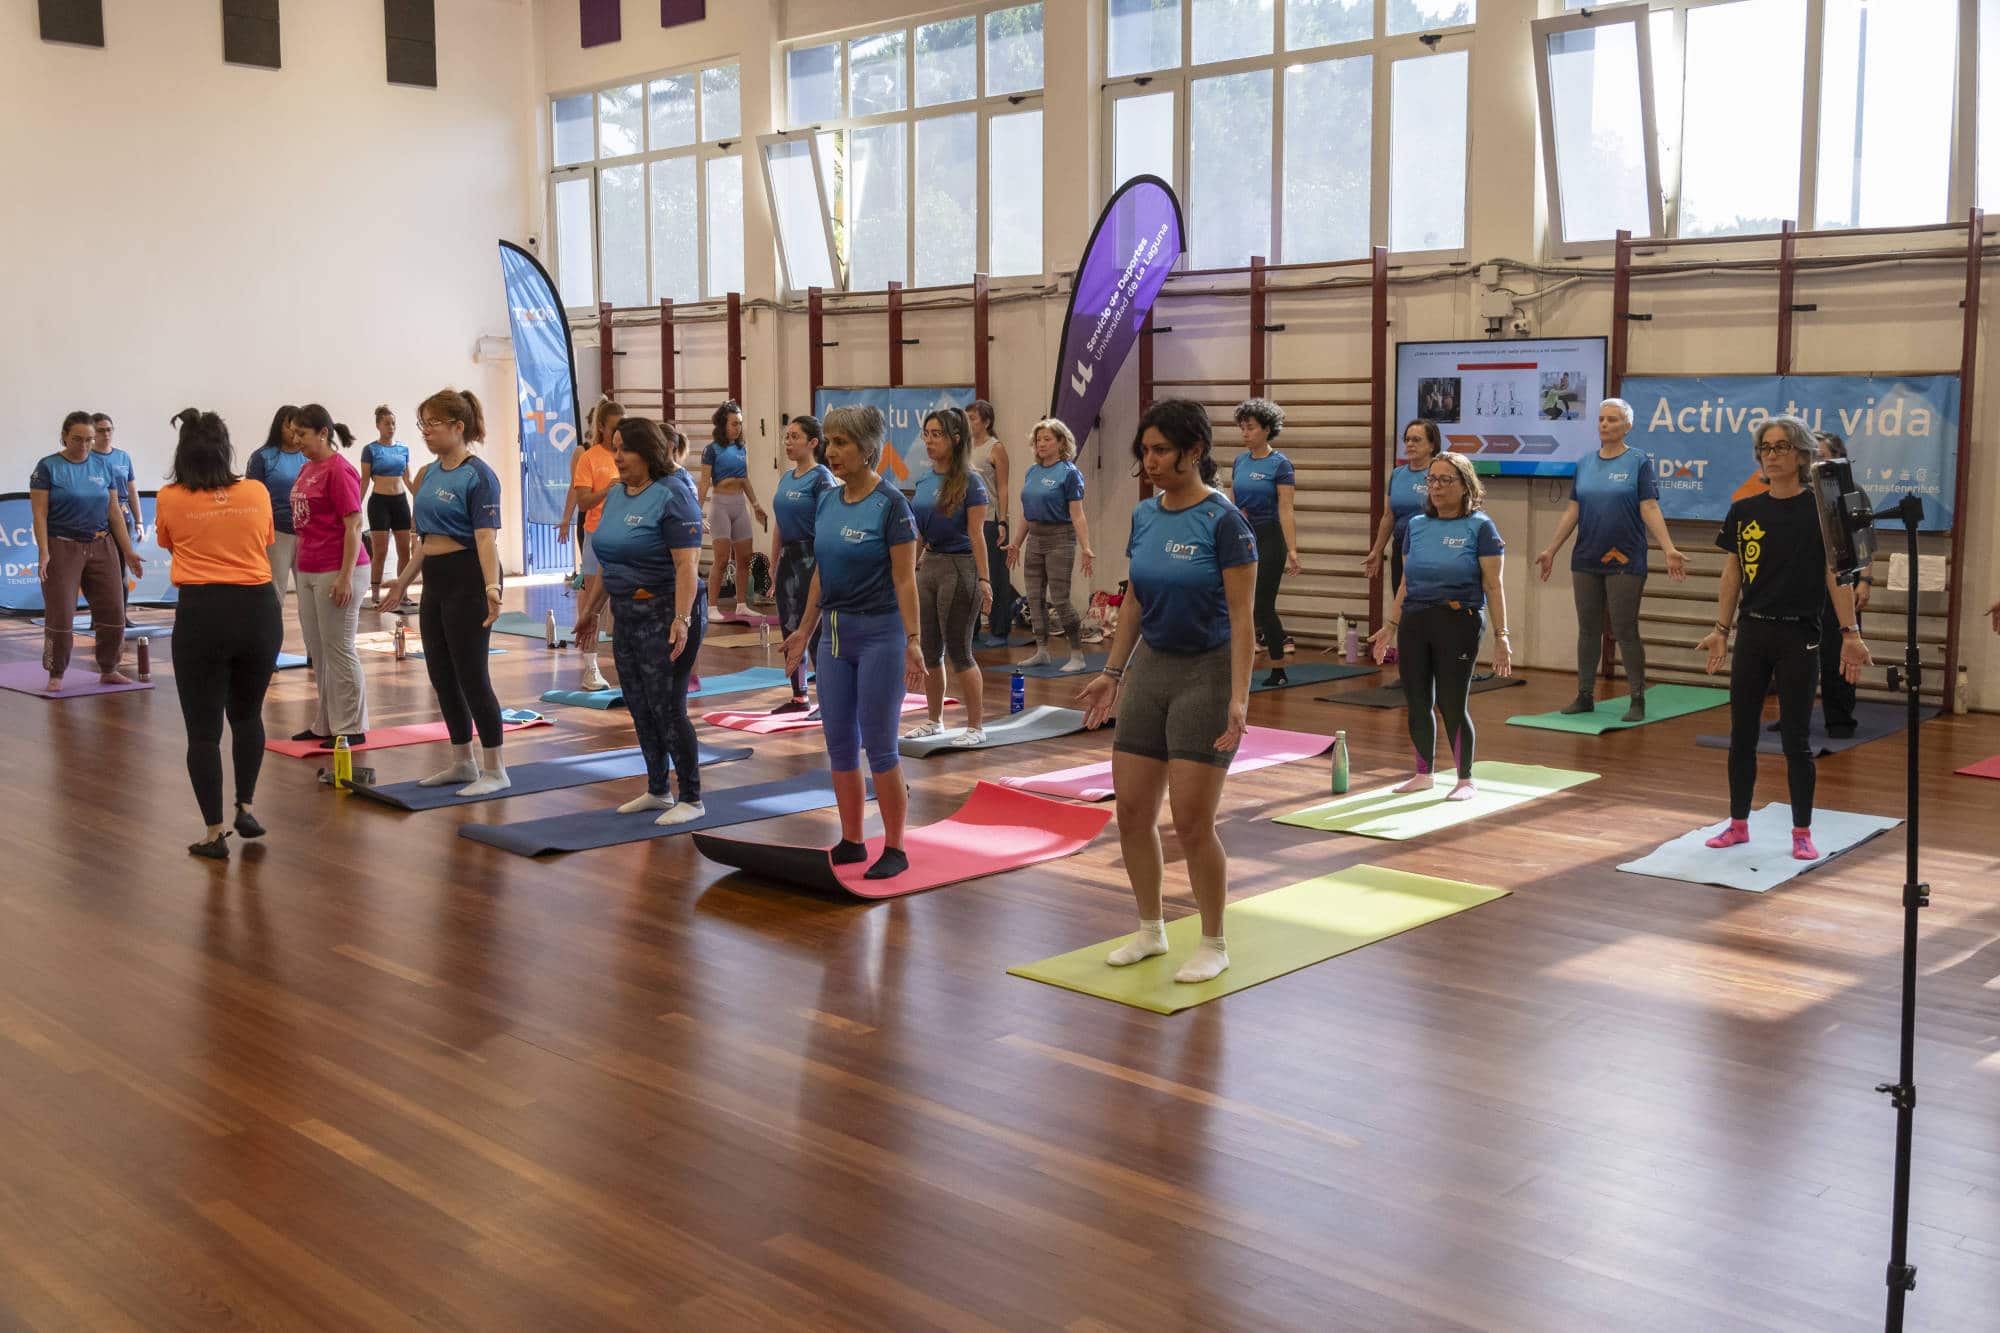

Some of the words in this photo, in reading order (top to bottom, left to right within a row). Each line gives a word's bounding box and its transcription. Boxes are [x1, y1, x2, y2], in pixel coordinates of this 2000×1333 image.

[1087, 307, 1111, 352] Servicio
[1110, 291, 1120, 307] de
[1118, 237, 1148, 290] Deportes
[1095, 297, 1129, 361] Universidad
[1128, 282, 1138, 297] de
[1136, 267, 1146, 281] La
[1144, 223, 1169, 266] Laguna
[1647, 397, 1769, 433] Activa
[1839, 398, 1931, 437] vida
[1659, 480, 1703, 490] TENERIFE
[0, 521, 38, 547] Act
